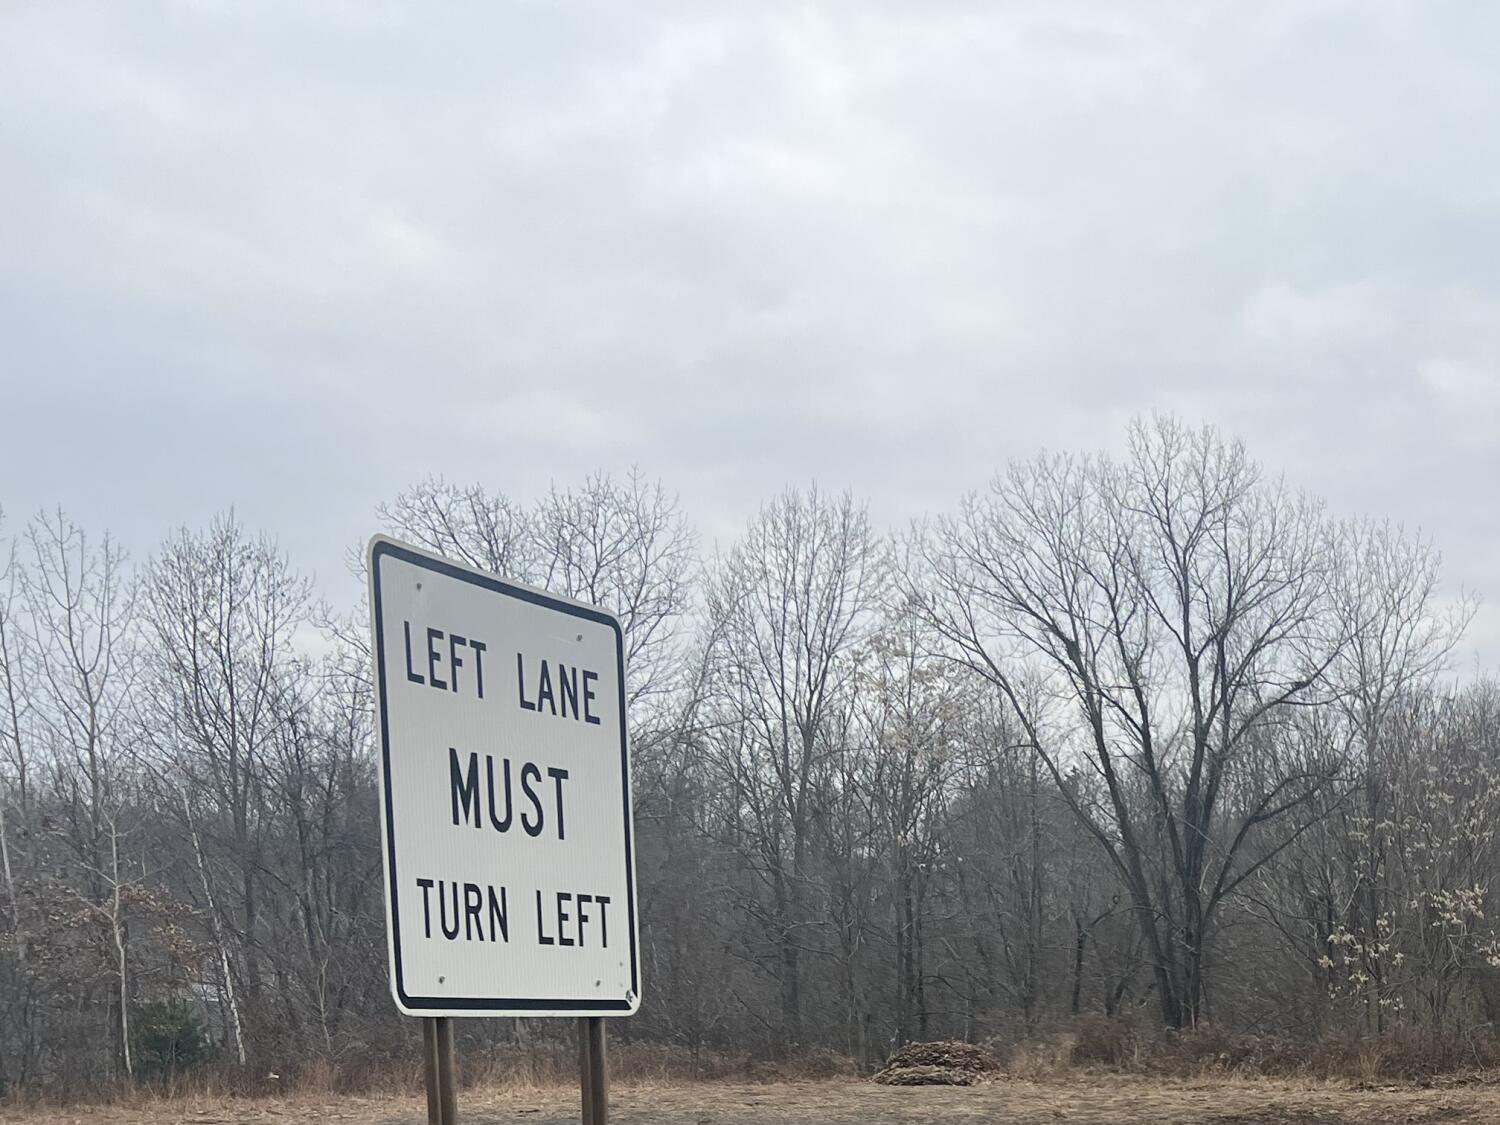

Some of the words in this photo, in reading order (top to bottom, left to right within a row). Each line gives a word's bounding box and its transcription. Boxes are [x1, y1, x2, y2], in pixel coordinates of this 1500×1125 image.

[403, 621, 487, 699] LEFT
[517, 652, 601, 725] LANE
[448, 747, 569, 841] MUST
[416, 877, 509, 943] TURN
[536, 889, 611, 948] LEFT
